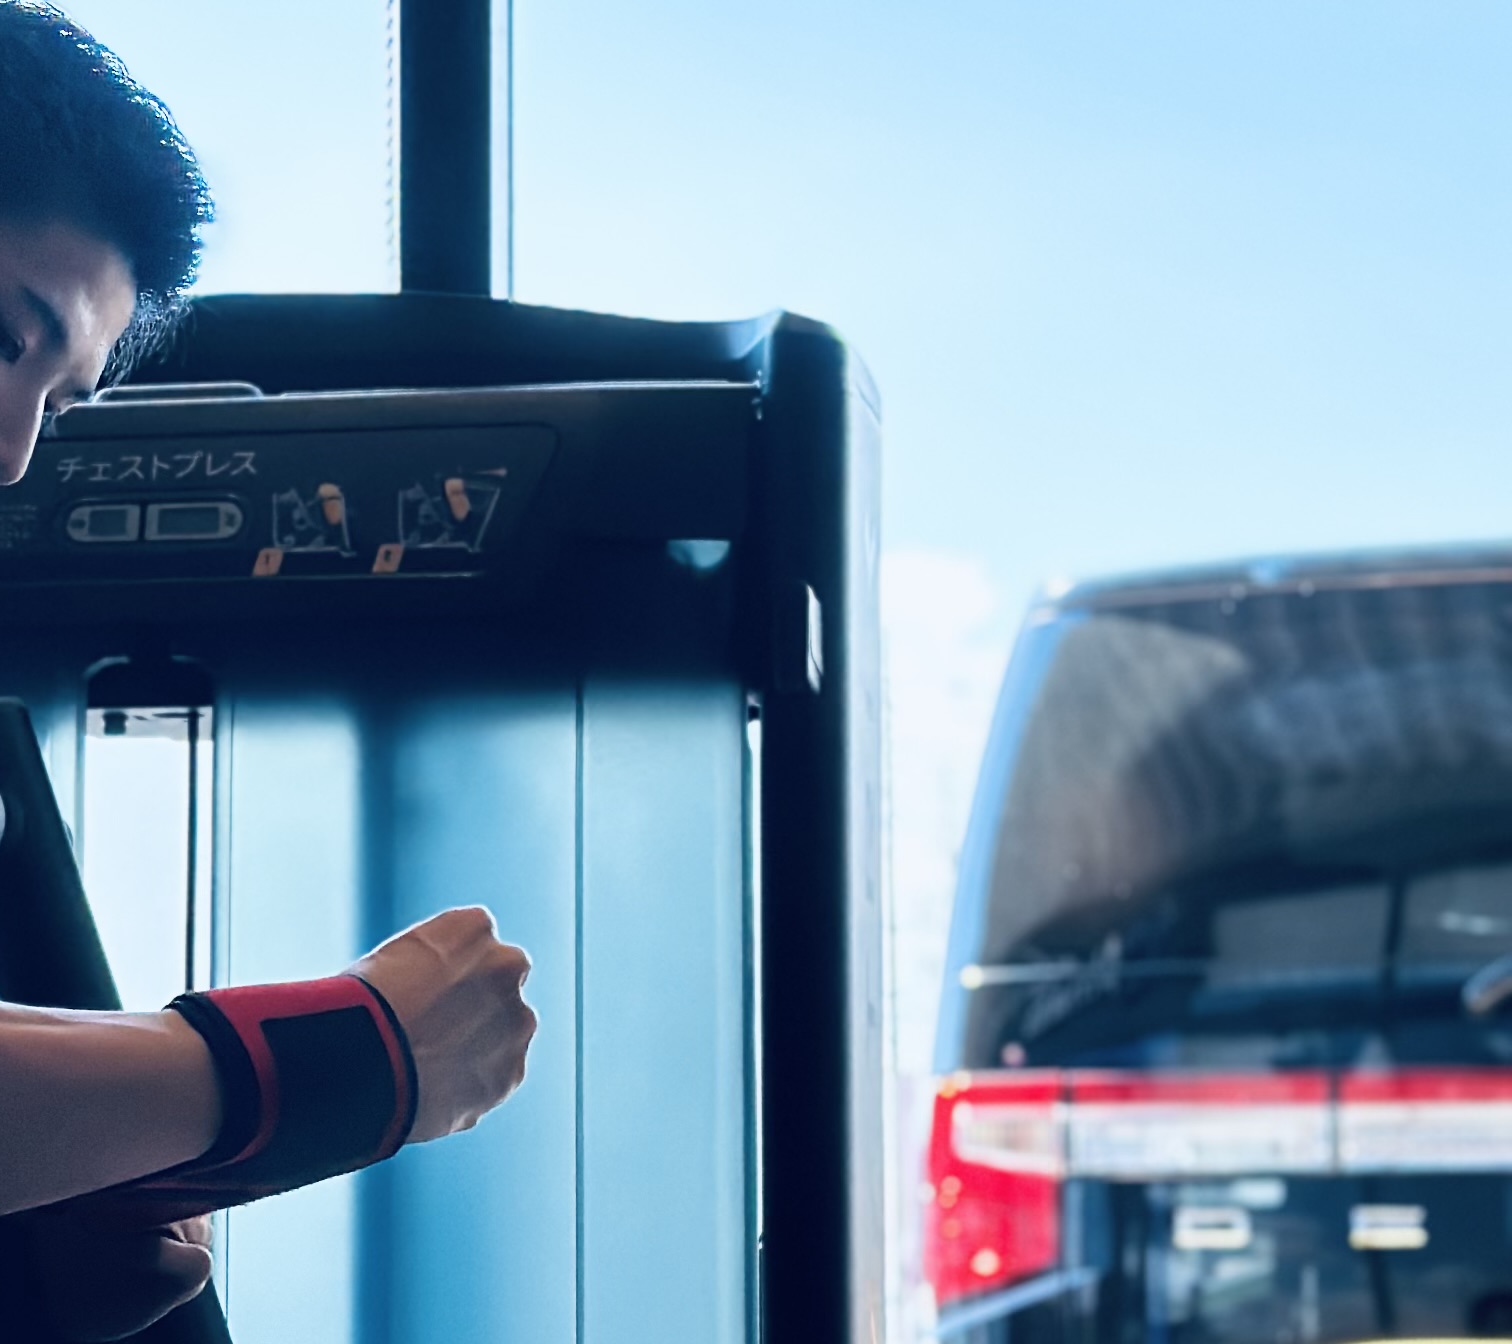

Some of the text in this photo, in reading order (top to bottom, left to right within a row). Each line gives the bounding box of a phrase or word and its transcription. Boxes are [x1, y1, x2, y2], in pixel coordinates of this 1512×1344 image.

[57, 451, 257, 482] チェストプレス
